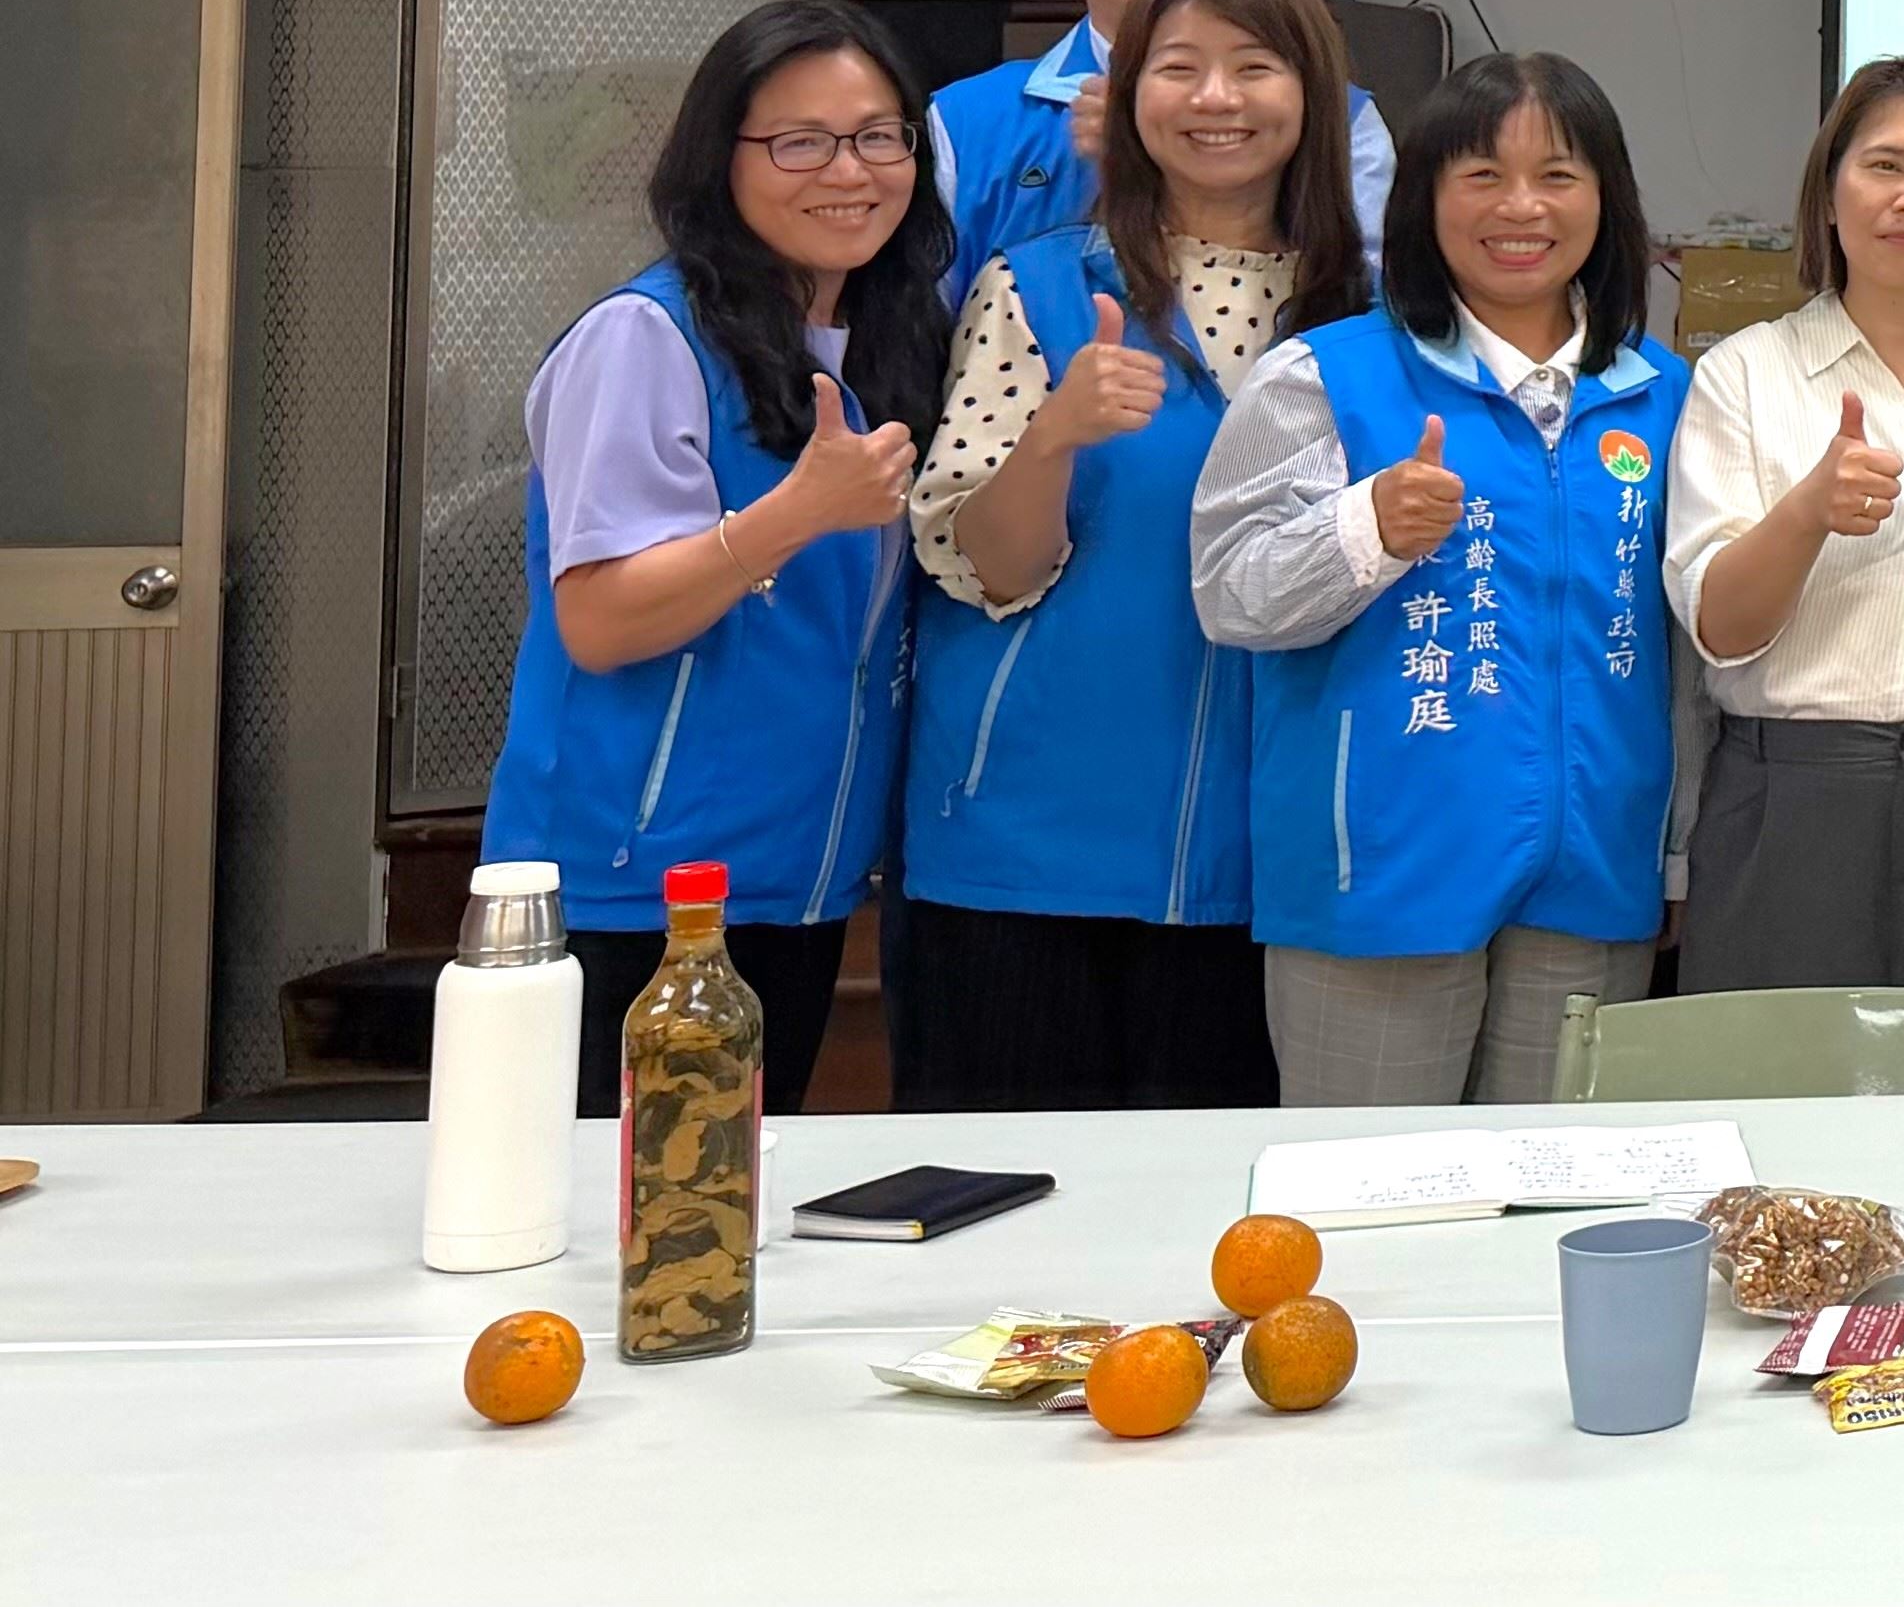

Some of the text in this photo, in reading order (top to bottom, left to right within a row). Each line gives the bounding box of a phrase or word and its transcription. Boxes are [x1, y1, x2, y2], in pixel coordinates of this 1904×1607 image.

[1400, 590, 1458, 735] 許瑜庭
[1465, 496, 1502, 696] 高齡長照處
[1605, 485, 1647, 679] 新竹縣政府
